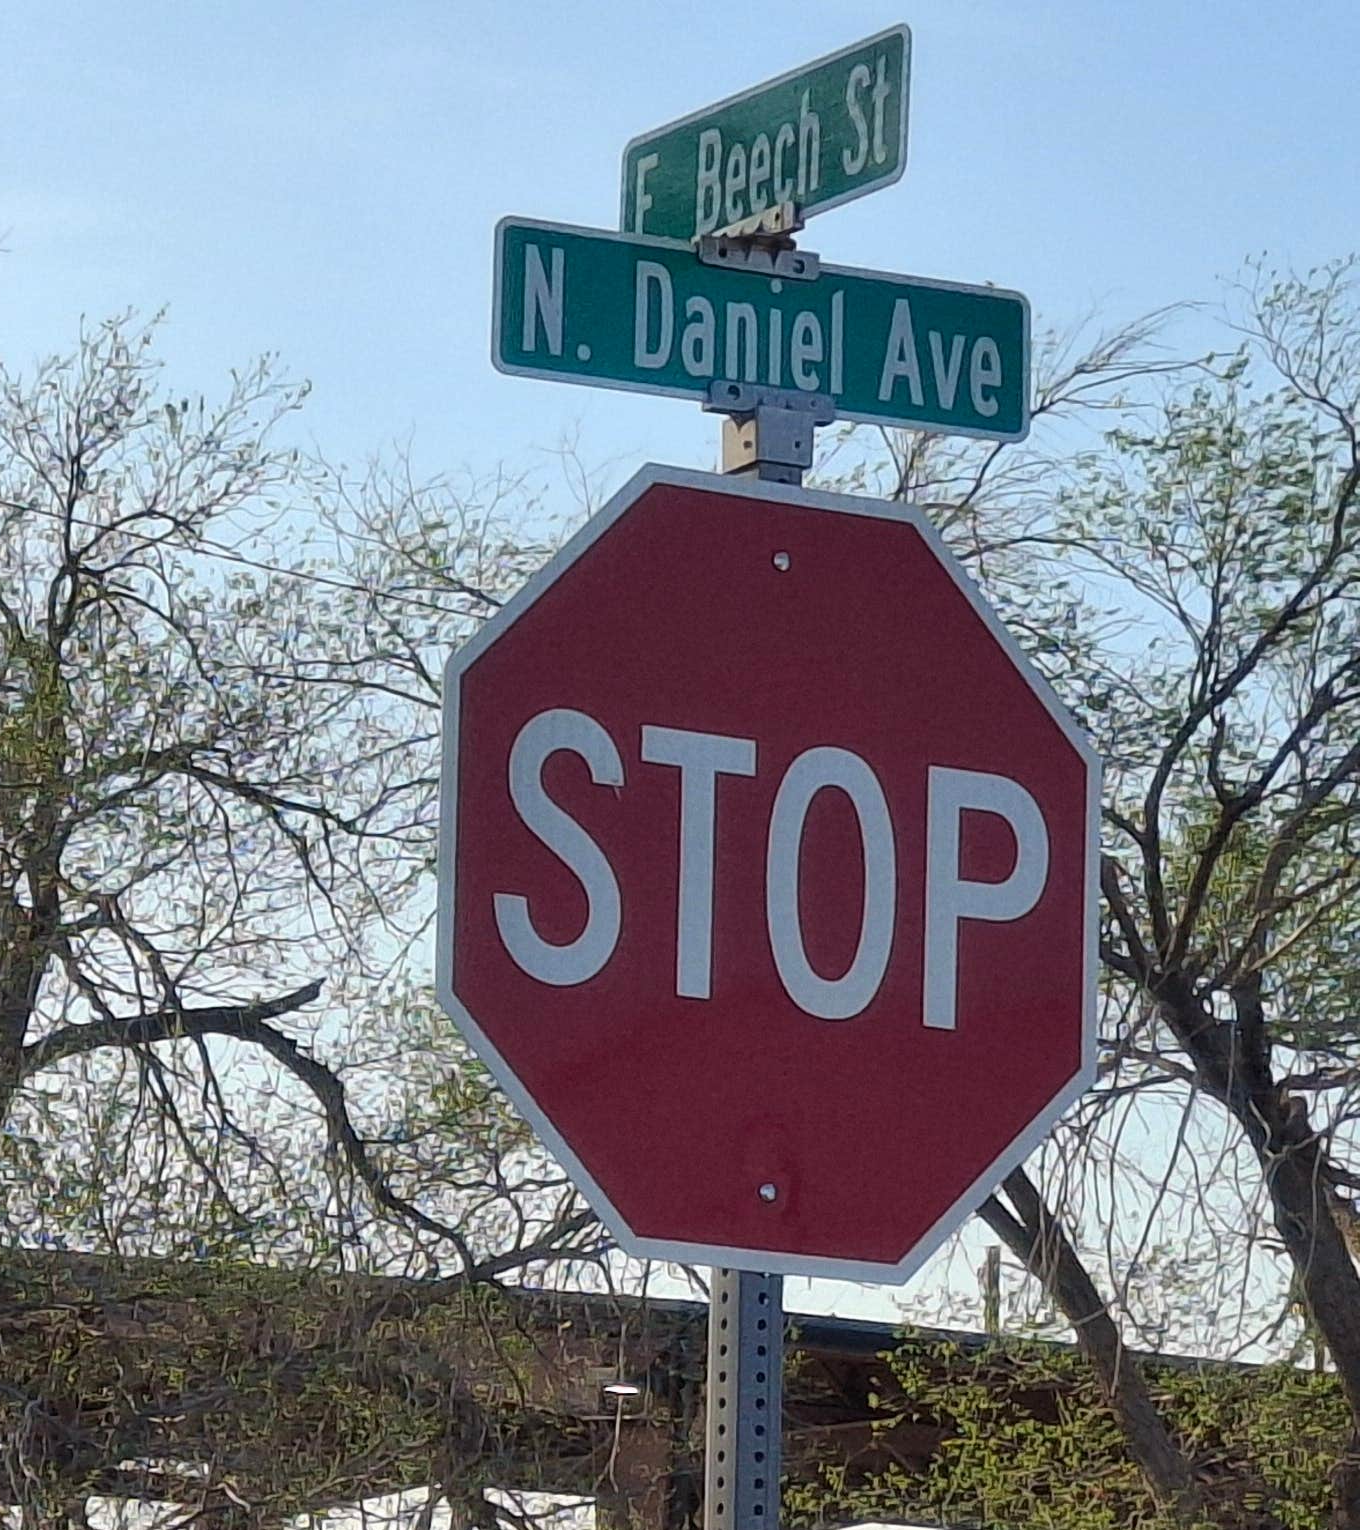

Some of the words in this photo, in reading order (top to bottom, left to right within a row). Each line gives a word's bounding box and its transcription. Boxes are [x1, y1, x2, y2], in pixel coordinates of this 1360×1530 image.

[695, 87, 821, 237] Beech
[842, 54, 892, 176] St
[521, 243, 592, 362] N.
[633, 259, 844, 395] Daniel
[878, 298, 1003, 418] Ave
[492, 707, 1051, 1031] STOP
